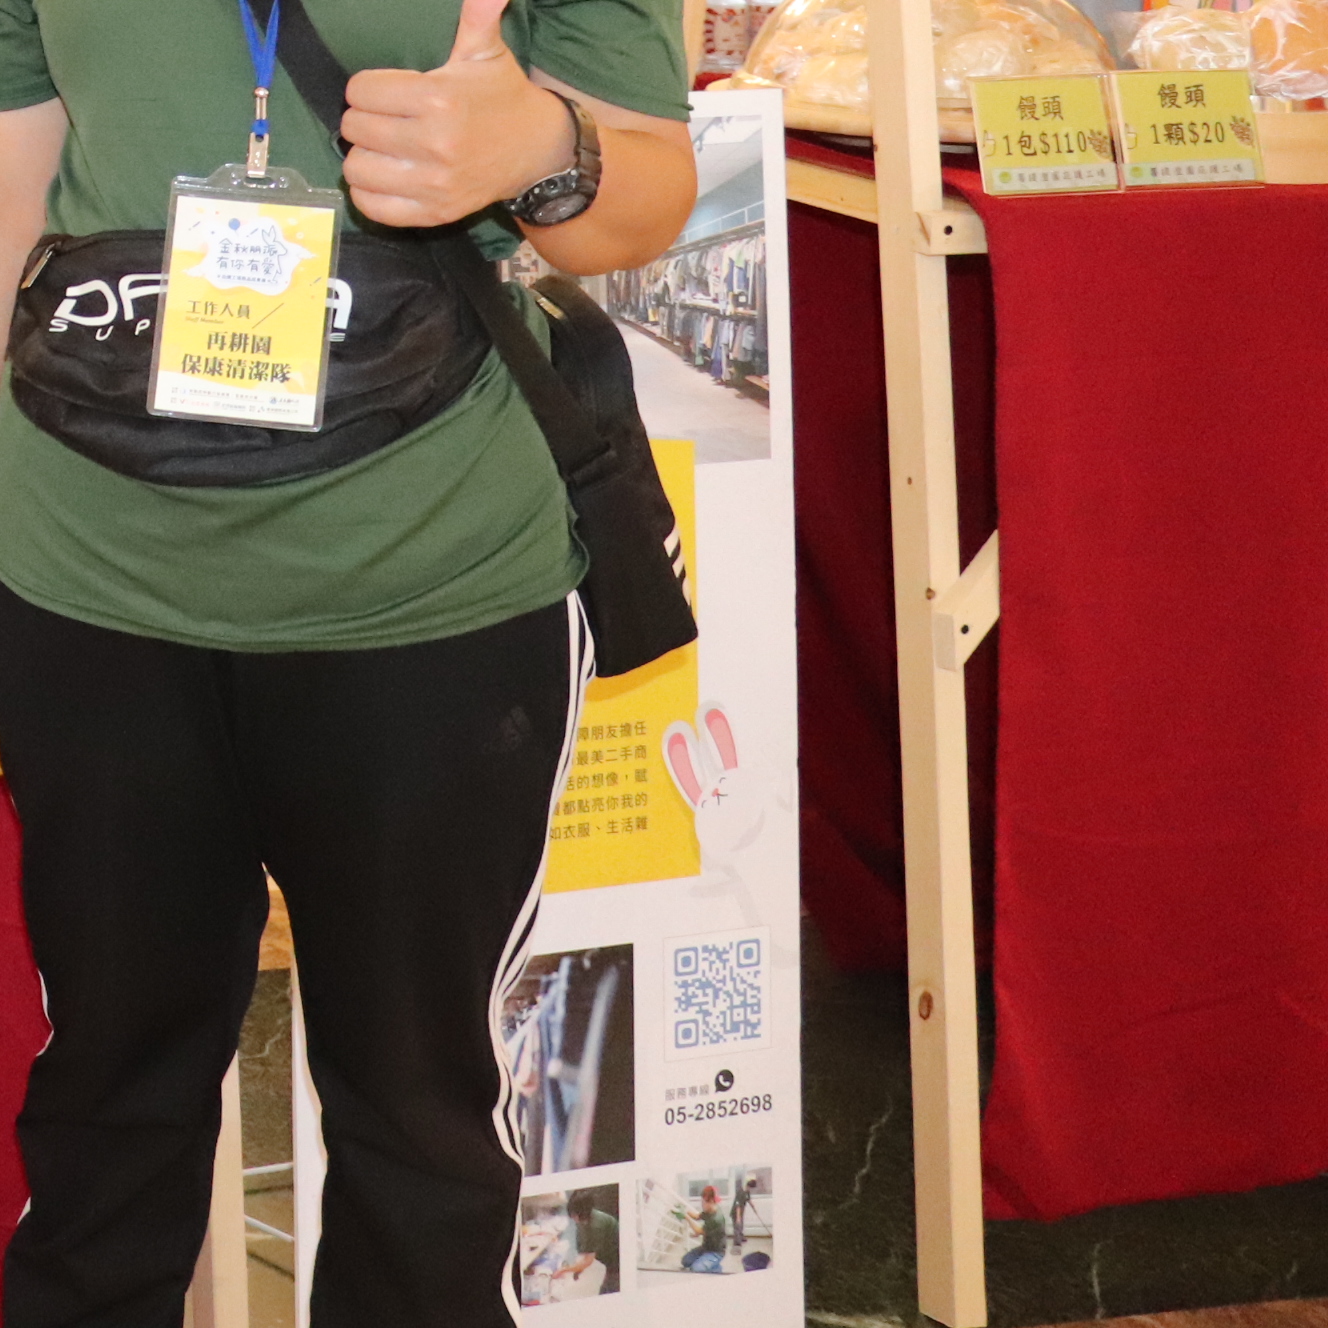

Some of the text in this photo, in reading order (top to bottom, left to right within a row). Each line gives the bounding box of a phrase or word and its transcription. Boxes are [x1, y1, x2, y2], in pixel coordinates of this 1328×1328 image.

[1017, 94, 1064, 121] 饅頭
[1157, 82, 1207, 109] 饅頭
[1002, 130, 1088, 157] 1包$110
[1150, 121, 1225, 146] 1顆$20
[186, 300, 251, 320] 工作人員
[206, 331, 272, 355] 再耕園
[180, 353, 292, 383] 保康清潔隊
[664, 1093, 773, 1126] 05-2852698
